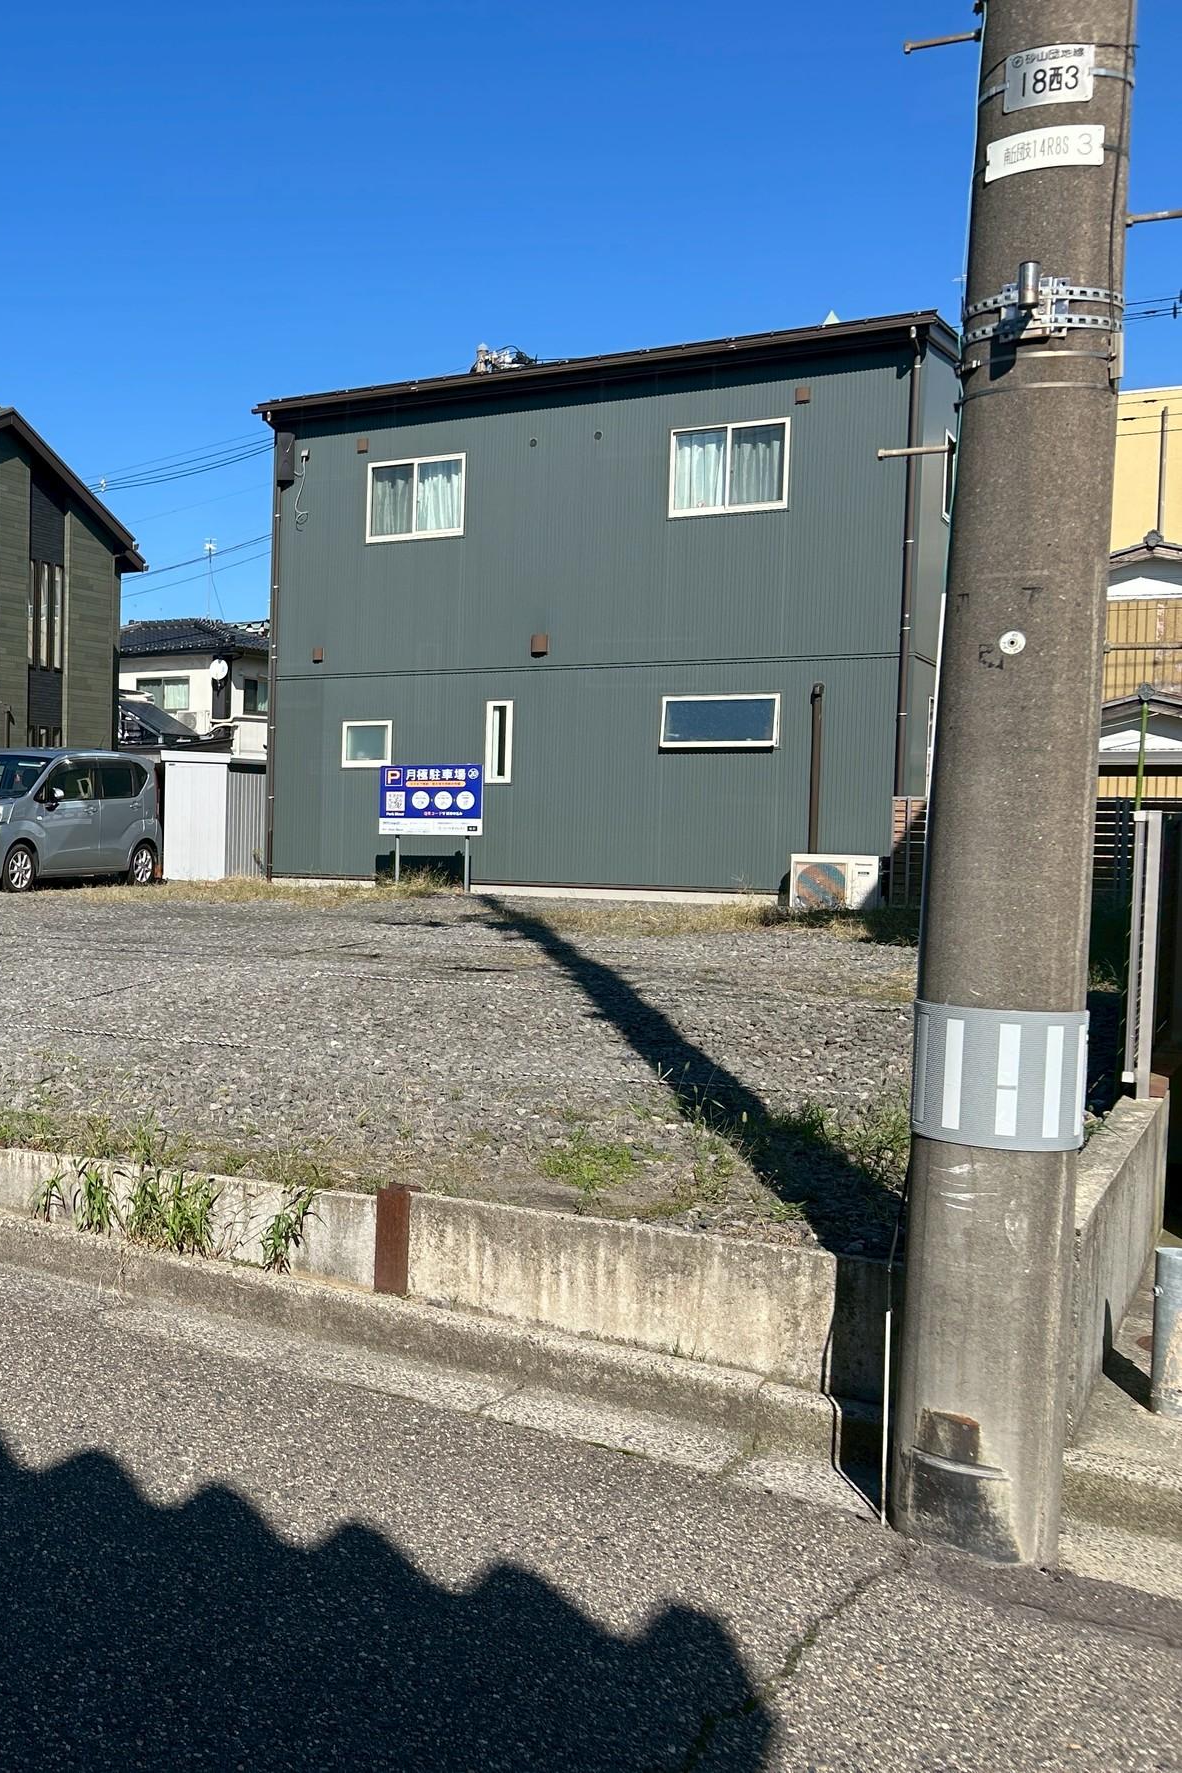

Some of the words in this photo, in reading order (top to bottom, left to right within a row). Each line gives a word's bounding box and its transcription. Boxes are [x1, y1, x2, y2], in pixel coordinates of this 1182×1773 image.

[1021, 65, 1079, 97] 18西3
[1076, 133, 1093, 156] 3
[387, 770, 400, 784] P
[406, 769, 466, 780] 月極駐車場
